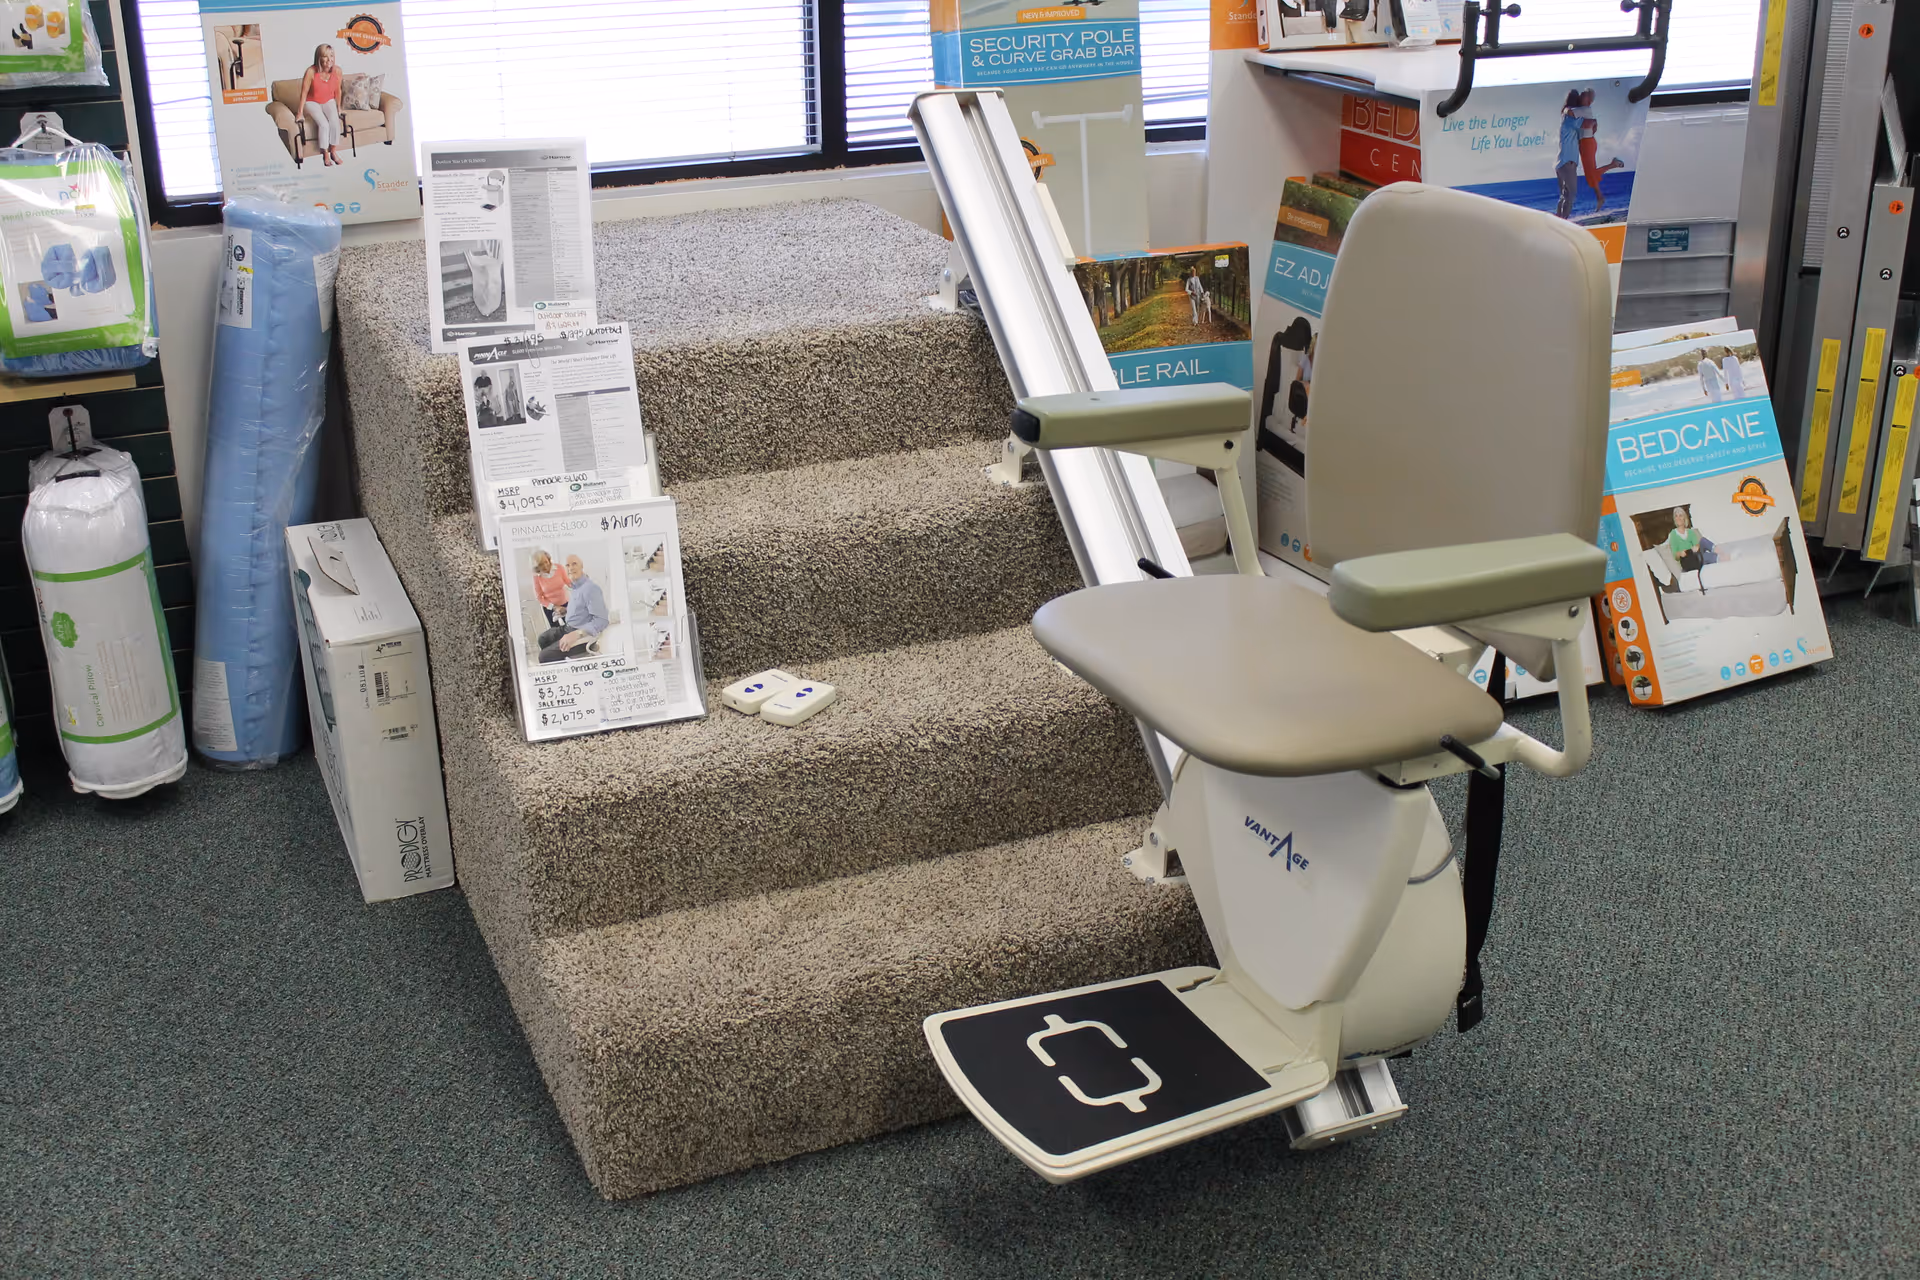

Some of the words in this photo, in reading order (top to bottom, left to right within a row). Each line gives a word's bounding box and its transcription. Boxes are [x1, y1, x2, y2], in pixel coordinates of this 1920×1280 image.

[1023, 12, 1038, 20] NEW
[970, 32, 1075, 53] SECURITY
[1081, 28, 1135, 46] POLE
[972, 55, 985, 67] &
[988, 50, 1047, 66] CURVE
[1050, 48, 1097, 61] GRAB
[1101, 45, 1135, 58] BAR
[1442, 118, 1465, 133] Live
[1469, 115, 1487, 129] the
[1491, 114, 1530, 131] Longer
[1471, 137, 1491, 153] Life
[1493, 136, 1513, 149] You
[1517, 131, 1546, 148] Love!
[377, 180, 409, 189] Stander
[1274, 256, 1296, 278] EZ
[473, 347, 508, 361] PINNACLE
[1156, 358, 1210, 381] RAIL
[1616, 411, 1764, 464] BEDCANE
[498, 486, 520, 496] MSRP
[511, 522, 559, 536] PINNACLE
[560, 519, 588, 531] SL300
[571, 662, 599, 674] Pinnacle
[601, 658, 626, 669] SL300
[86, 664, 97, 691] Pillow
[535, 674, 558, 684] MSRP
[93, 692, 105, 728] Cervical
[538, 699, 555, 708] SALE
[557, 698, 576, 706] PRICE
[418, 816, 428, 845] OVERLAY
[1245, 816, 1310, 872] VANTAGE
[422, 846, 432, 878] MATTRESS
